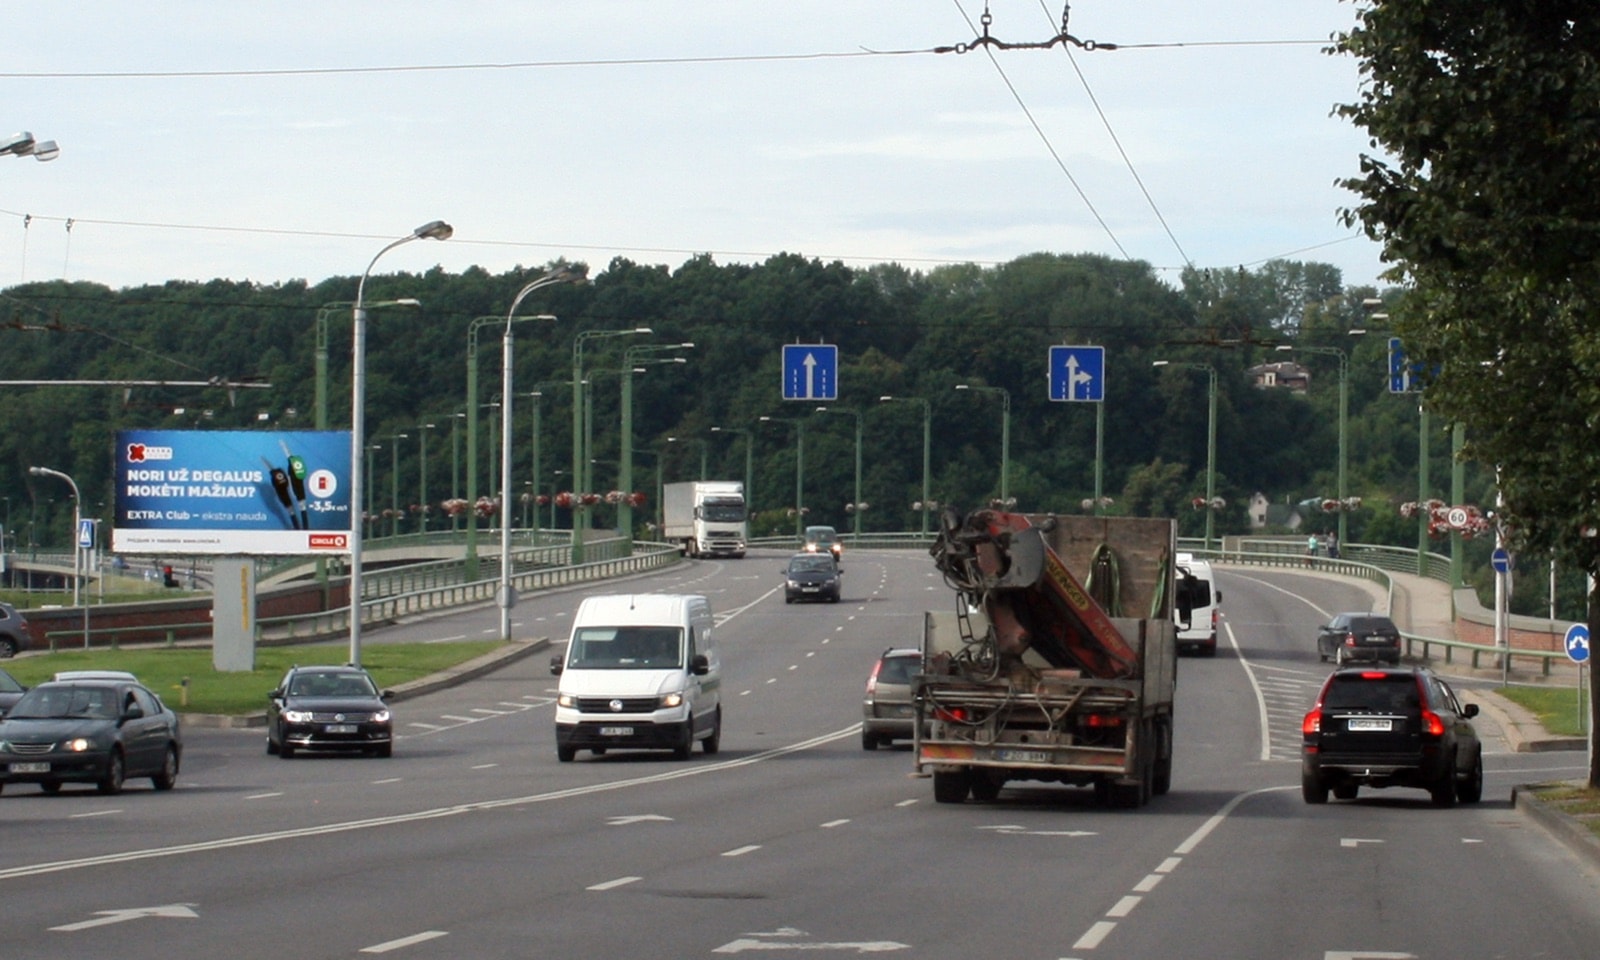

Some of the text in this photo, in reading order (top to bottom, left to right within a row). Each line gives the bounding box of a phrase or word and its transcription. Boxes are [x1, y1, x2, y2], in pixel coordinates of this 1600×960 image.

[127, 468, 263, 482] NORI UŽ DEGALUS
[127, 483, 256, 497] MOKĖTI MAŽIAU?
[127, 511, 163, 520] EXTRA
[166, 510, 191, 520] Club
[202, 512, 233, 521] ekstra
[235, 512, 268, 521] nauda
[1451, 513, 1465, 521] 60
